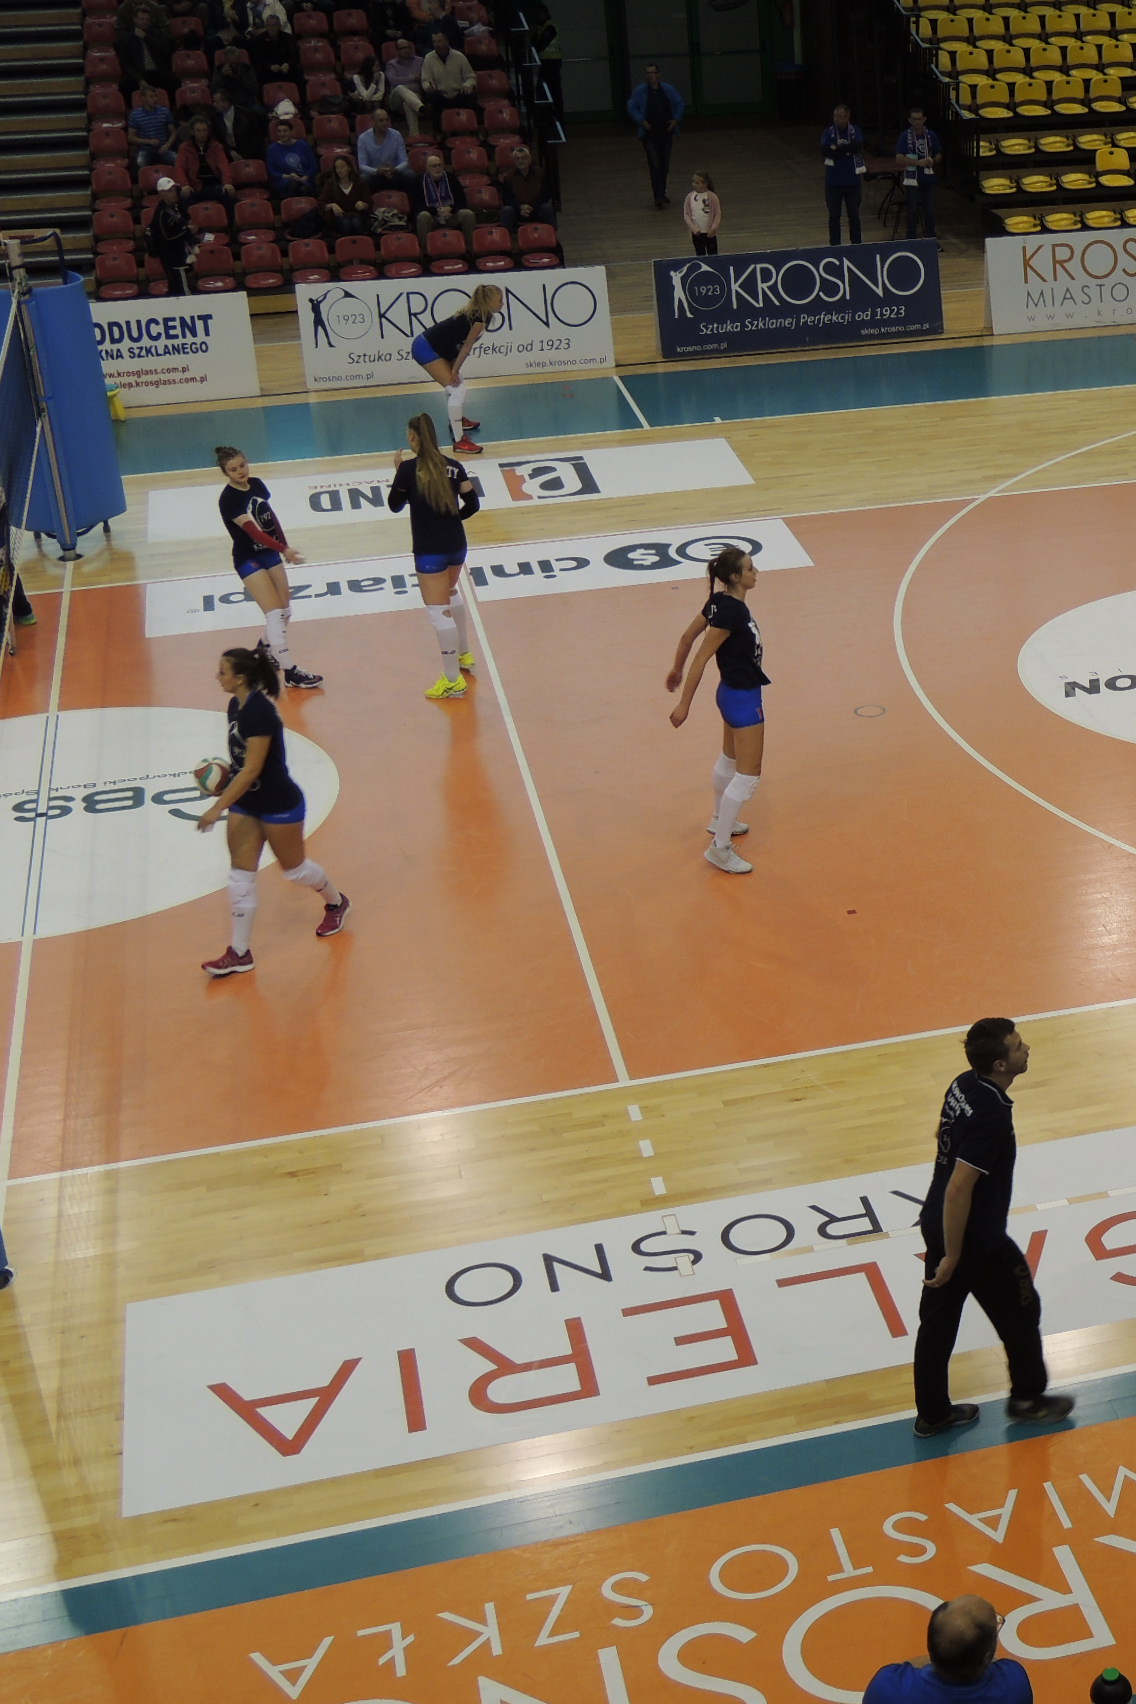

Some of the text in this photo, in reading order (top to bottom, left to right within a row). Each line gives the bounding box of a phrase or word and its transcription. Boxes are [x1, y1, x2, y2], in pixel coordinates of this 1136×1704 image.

[694, 284, 720, 297] 1923
[729, 251, 925, 309] KROSNO
[1026, 281, 1130, 309] MIASTO
[93, 313, 213, 347] ODUCENT
[335, 312, 366, 326] 1923
[699, 305, 906, 336] Sztuka Szklanej Perfekcji od 1923
[128, 341, 209, 360] SZKLANEGO
[347, 350, 392, 365] Sztuka
[517, 340, 533, 353] od
[538, 338, 571, 352] 1923
[313, 371, 374, 383] krosno.com.pl
[445, 1189, 926, 1308] ROSNO
[249, 1571, 655, 1701] SZKŁA
